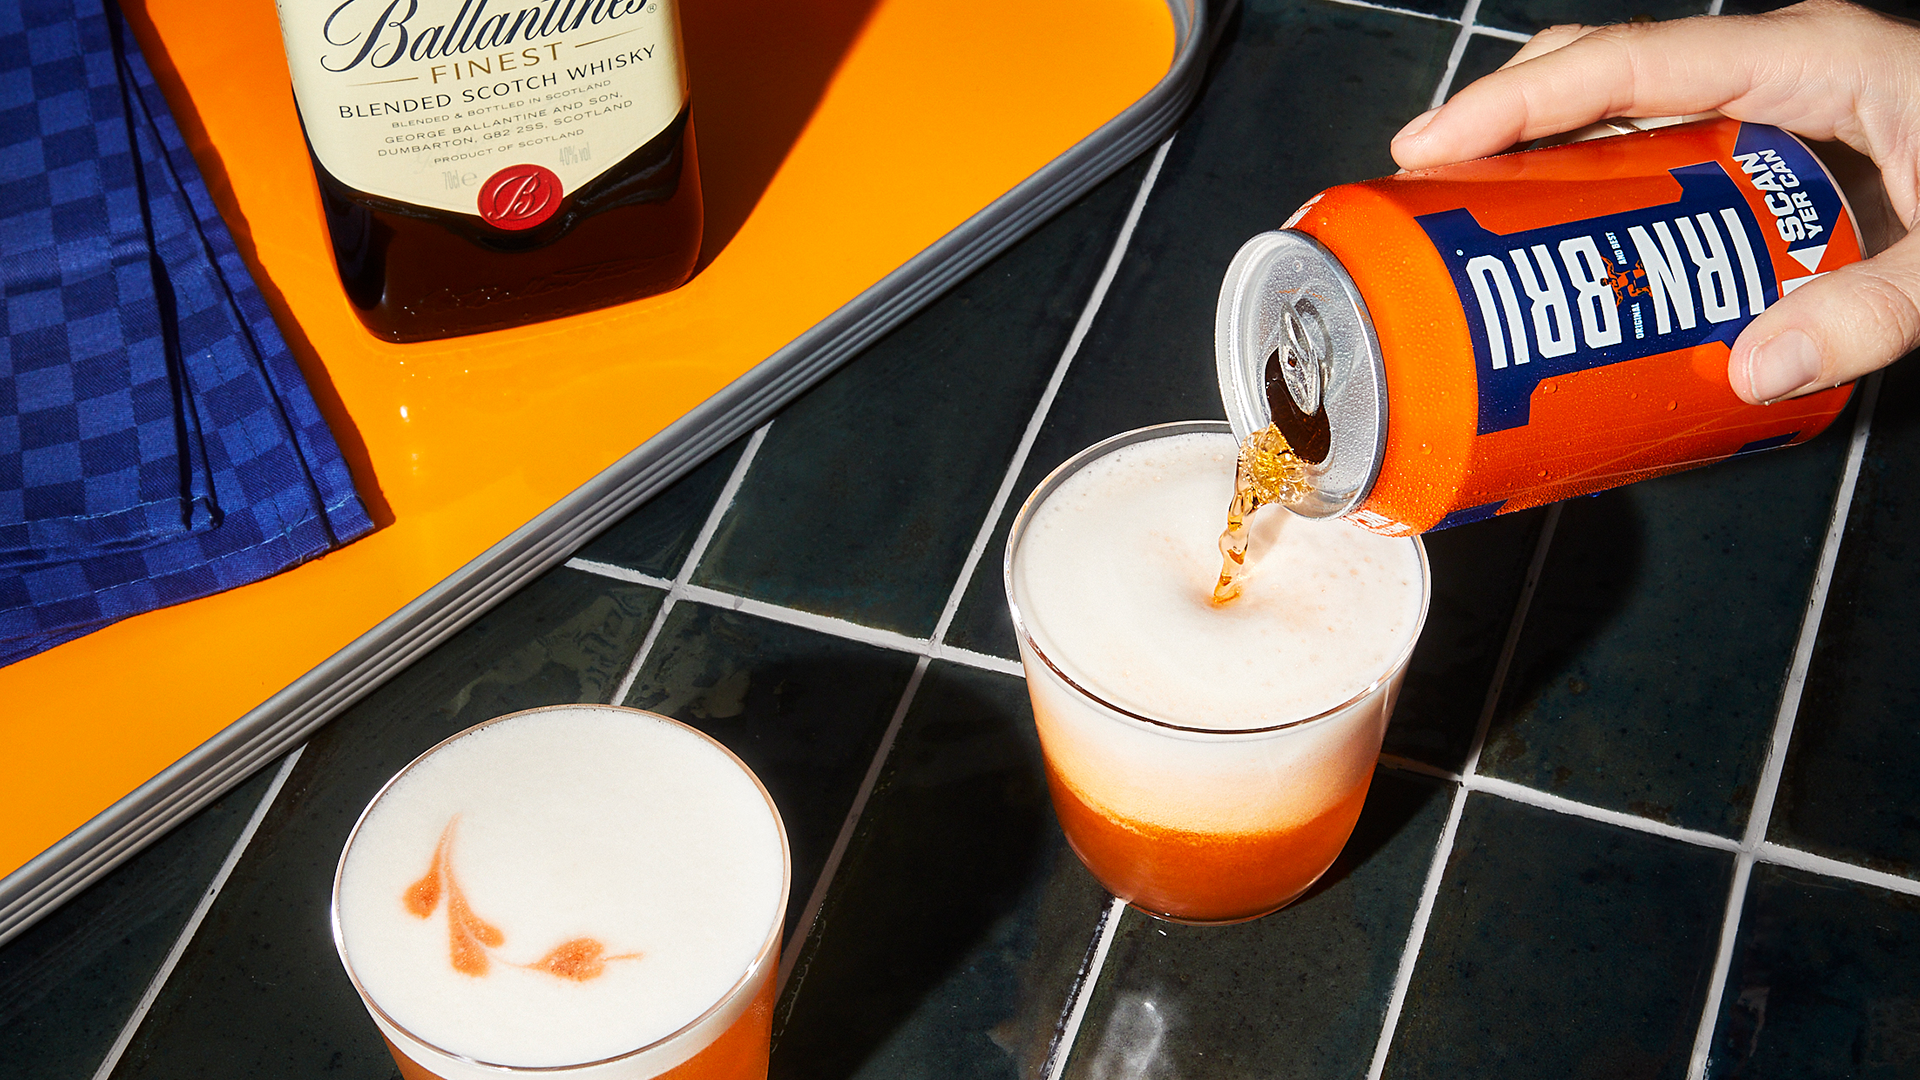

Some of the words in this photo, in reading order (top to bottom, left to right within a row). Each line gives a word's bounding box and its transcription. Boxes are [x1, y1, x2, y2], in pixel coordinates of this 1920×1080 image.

[338, 93, 452, 119] BLENDED
[462, 72, 558, 103] SCOTCH
[566, 43, 656, 81] WHISKY
[430, 41, 563, 84] FINEST
[384, 128, 446, 144] GEORGE
[452, 108, 548, 135] BALLANTINE
[553, 101, 584, 115] AND
[391, 114, 450, 129] BLENDED
[467, 100, 525, 117] BOTTLED
[528, 96, 541, 105] IN
[545, 79, 612, 101] SCOTLAND
[483, 128, 511, 141] G82
[553, 99, 634, 126] SCOTLAND
[434, 147, 493, 164] PRODUCT
[498, 144, 514, 153] OF
[518, 128, 585, 148] SCOTLAND
[559, 145, 579, 167] 40%
[1757, 149, 1801, 189] CAN
[1732, 152, 1806, 243] SCAN
[1790, 191, 1824, 240] YER
[1605, 231, 1621, 250] BEST
[1614, 249, 1628, 265] AND
[1627, 207, 1766, 336] IRN
[1465, 235, 1623, 370] BRU
[1631, 302, 1645, 339] ORIGINAL
